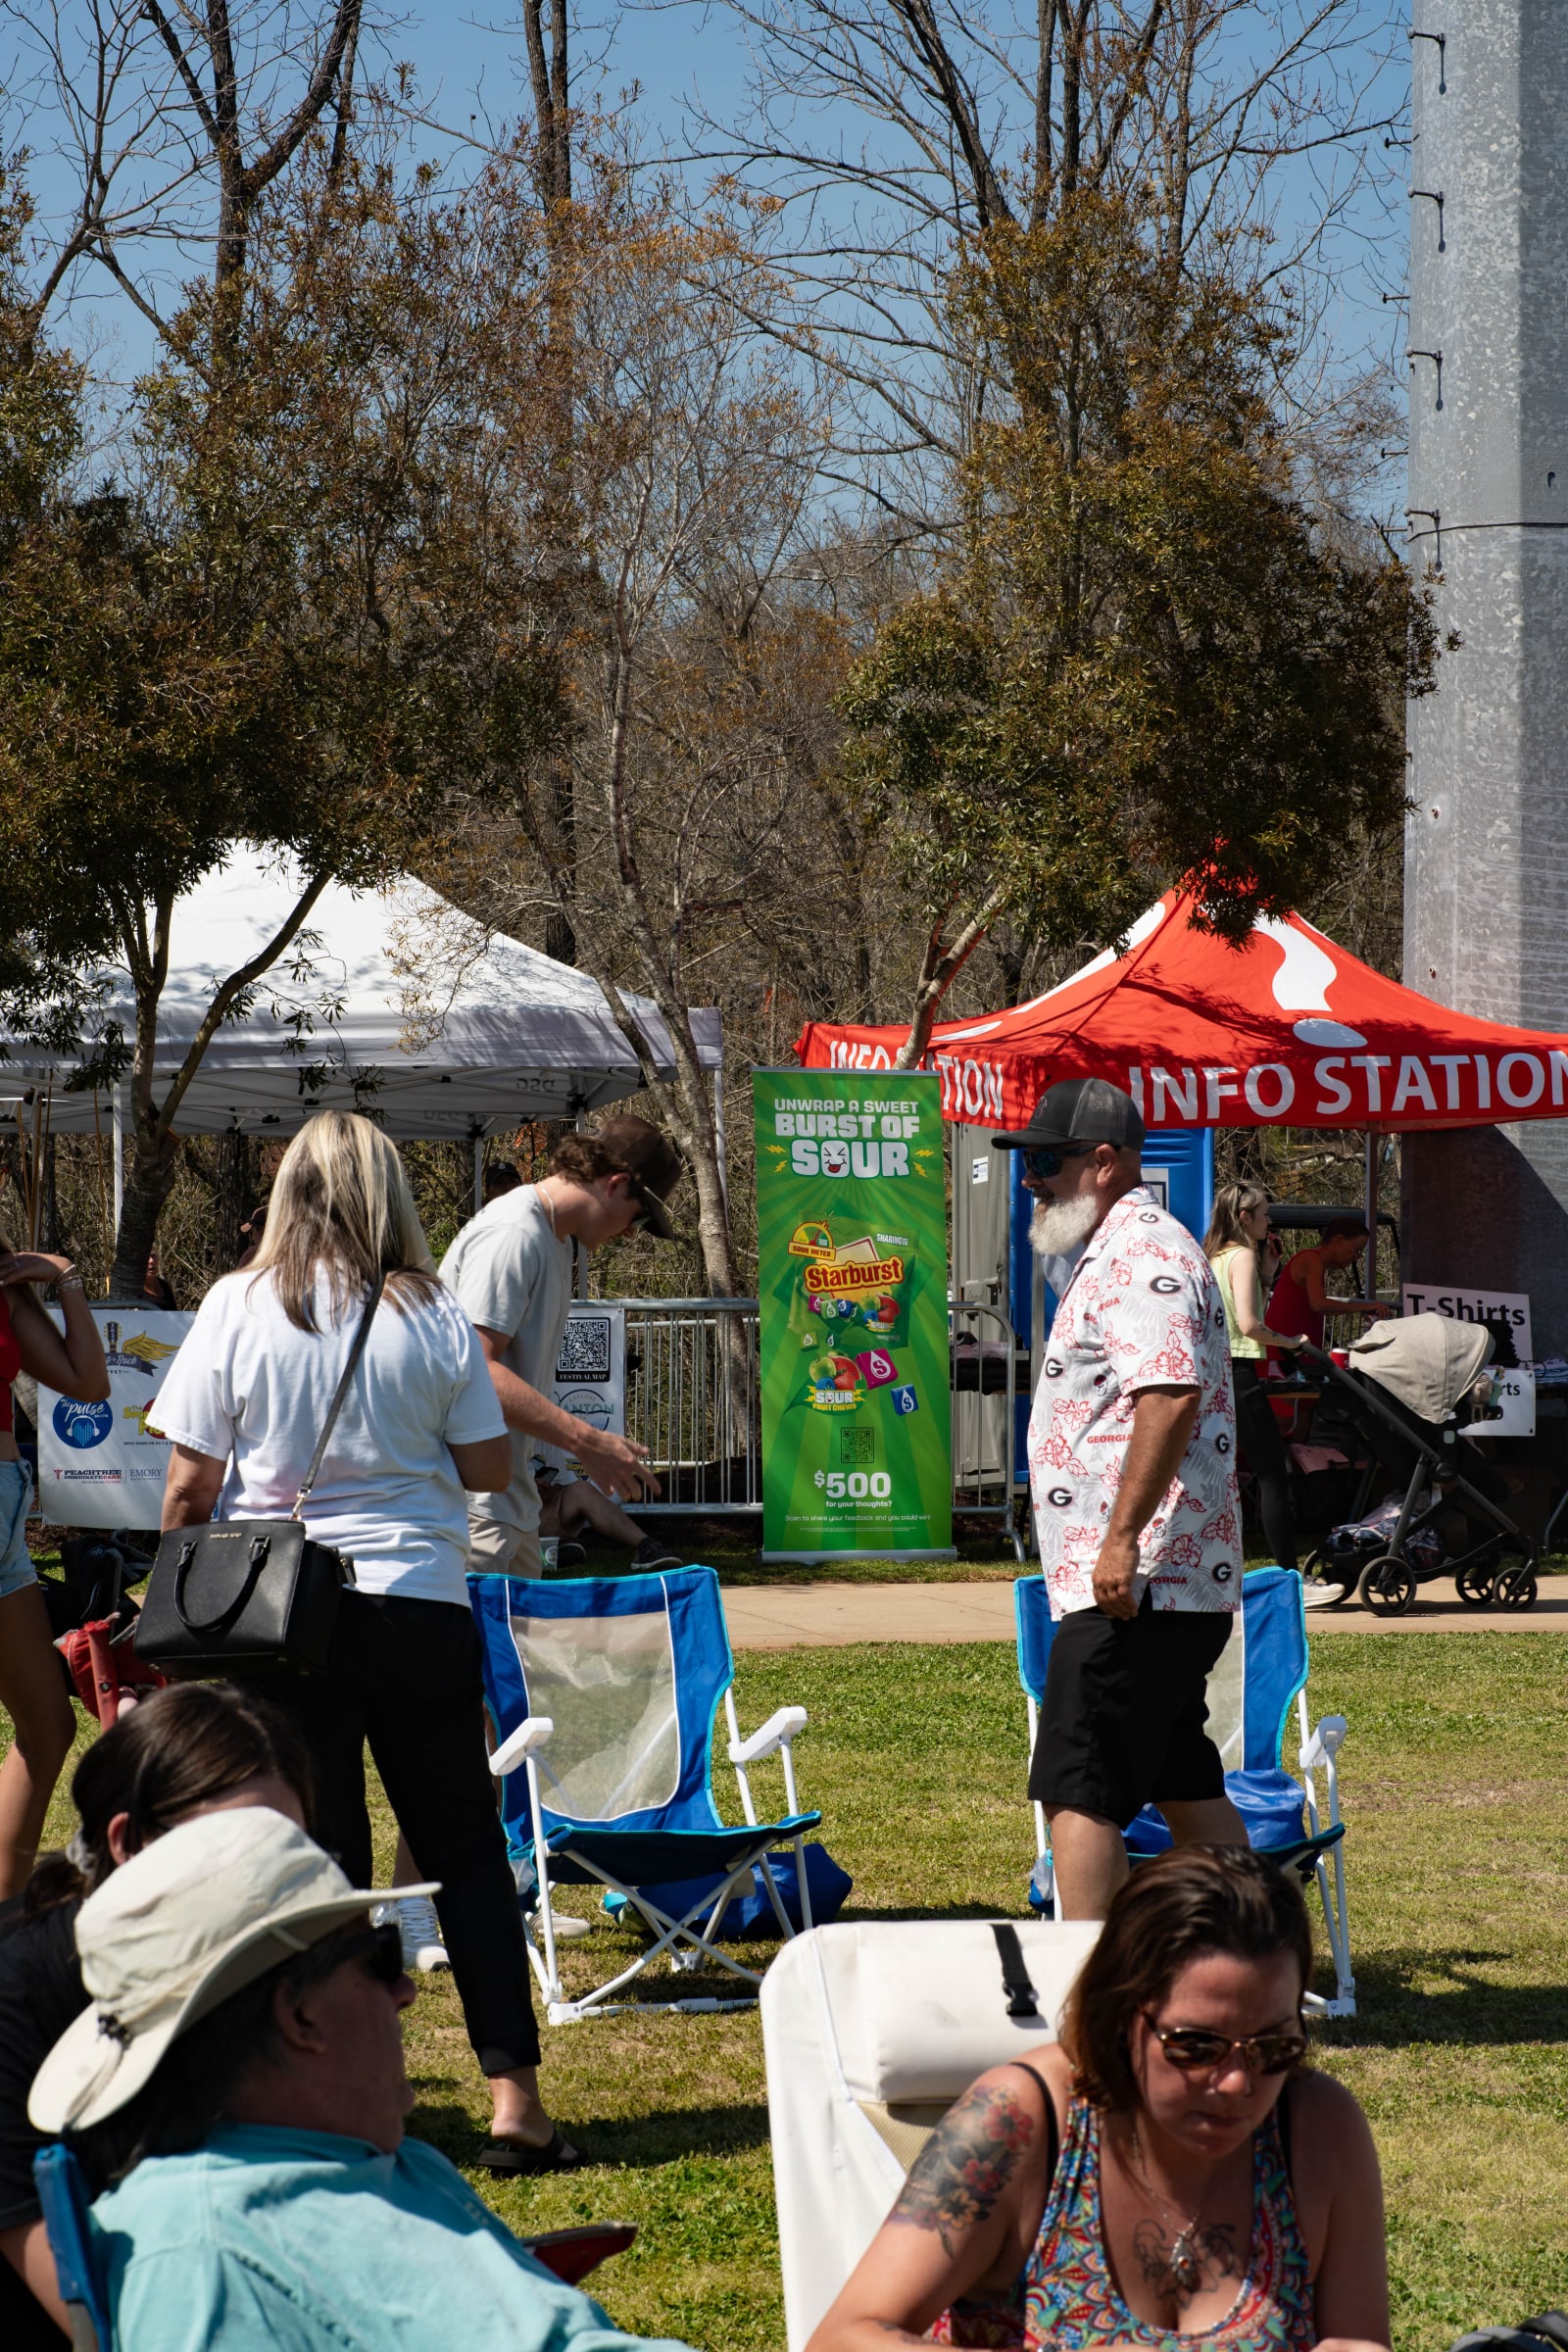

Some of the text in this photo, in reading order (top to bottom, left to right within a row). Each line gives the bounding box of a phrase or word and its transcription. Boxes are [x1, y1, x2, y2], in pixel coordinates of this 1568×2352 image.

[1128, 1063, 1295, 1122] INFO
[774, 1099, 919, 1114] UNWRAP A SWEET
[774, 1113, 920, 1139] BURST OF
[791, 1139, 910, 1179] SOUR
[876, 1233, 904, 1246] SHARING
[792, 1246, 831, 1258] SOUR METER
[808, 1259, 901, 1290] Starburst
[1149, 1277, 1182, 1294] G
[1406, 1294, 1526, 1326] T-Shirts
[117, 1354, 138, 1369] Rock
[871, 1360, 887, 1375] S
[1046, 1358, 1064, 1378] G
[815, 1390, 855, 1404] SOUR
[903, 1397, 913, 1410] S
[65, 1401, 105, 1423] pulse
[556, 1403, 615, 1415] ANTON
[1087, 1435, 1132, 1445] GEORGIA
[1215, 1435, 1229, 1453] G
[130, 1468, 162, 1477] EMORY
[814, 1470, 891, 1498] $500
[856, 1500, 892, 1509] thoughts?
[1049, 1488, 1072, 1506] G
[1149, 1575, 1187, 1586] EORGIA
[1214, 1564, 1231, 1581] G
